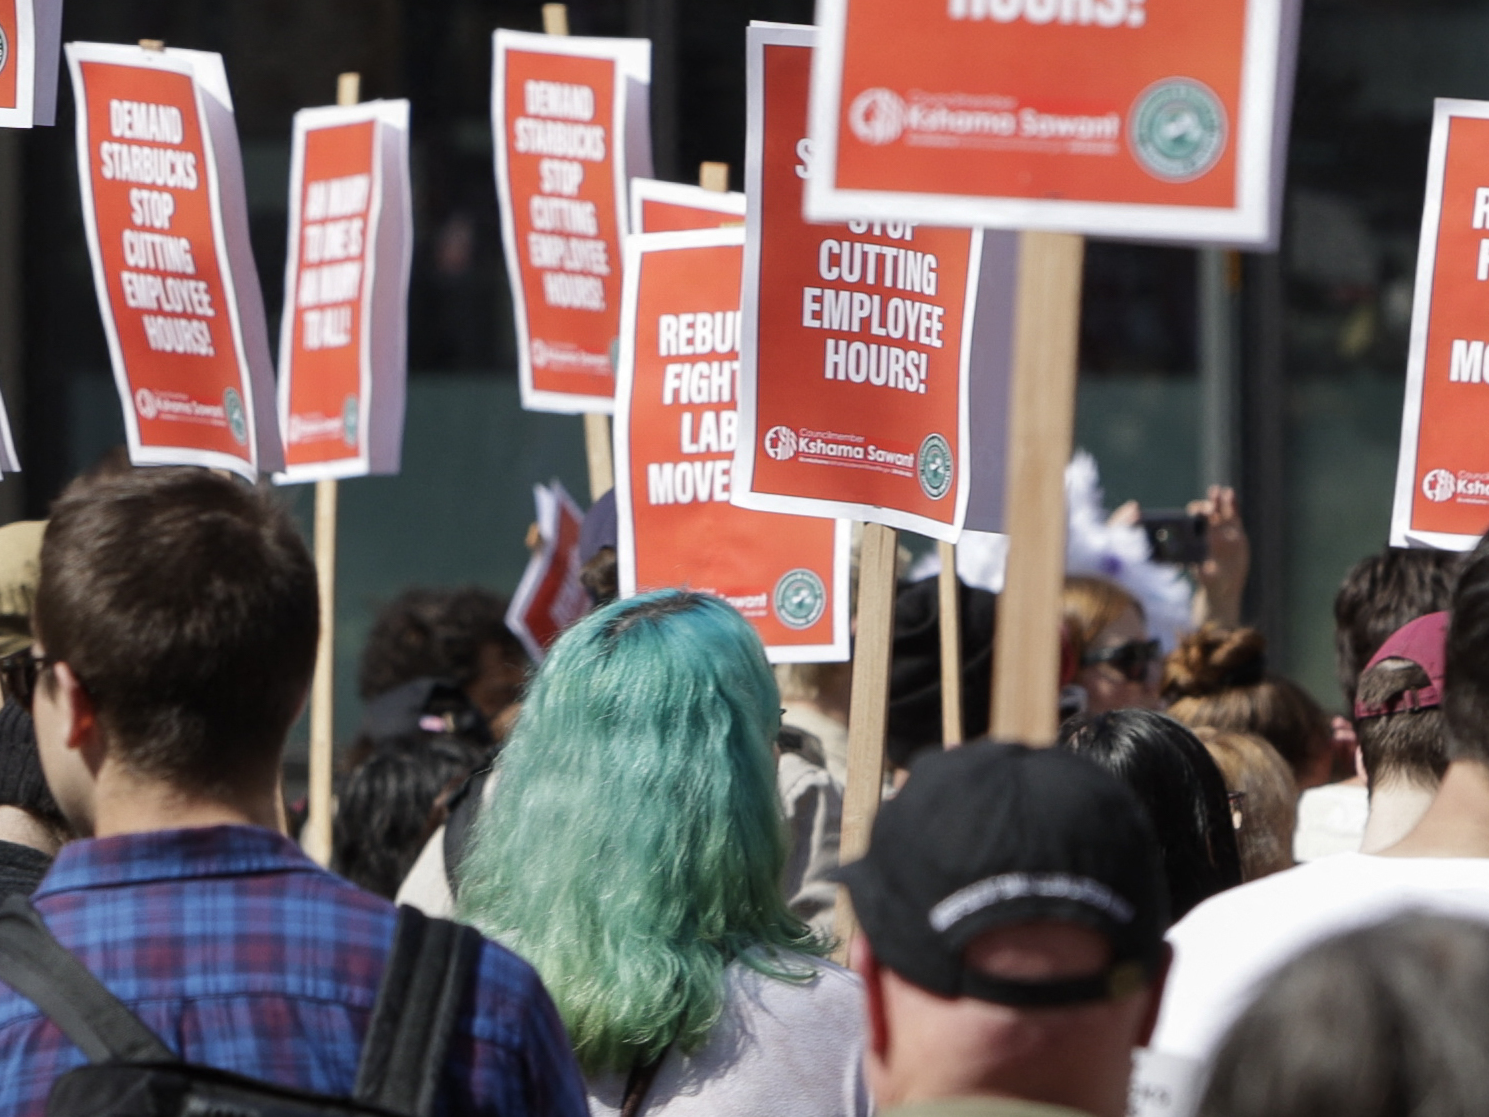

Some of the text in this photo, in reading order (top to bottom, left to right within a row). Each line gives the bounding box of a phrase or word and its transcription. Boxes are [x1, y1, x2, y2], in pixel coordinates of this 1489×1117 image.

[109, 99, 182, 145] DEMAND
[524, 79, 594, 121] DEMAND
[514, 117, 606, 162] STARBUCKS
[100, 142, 198, 189] STARBUCKS
[539, 159, 584, 195] STOP
[129, 188, 174, 229] STOP
[529, 194, 598, 236] CUTTING
[122, 229, 196, 274] CUTTING
[527, 232, 611, 276] EMPLOYEE
[819, 238, 938, 297] CUTTING
[121, 271, 215, 317] EMPLOYEE
[543, 272, 606, 310] HOURS!
[144, 315, 214, 356] HOURS!
[801, 286, 945, 349] EMPLOYEE
[823, 338, 928, 395] HOURS!
[681, 409, 738, 454] LAB
[798, 438, 915, 467] Kshama Sawant
